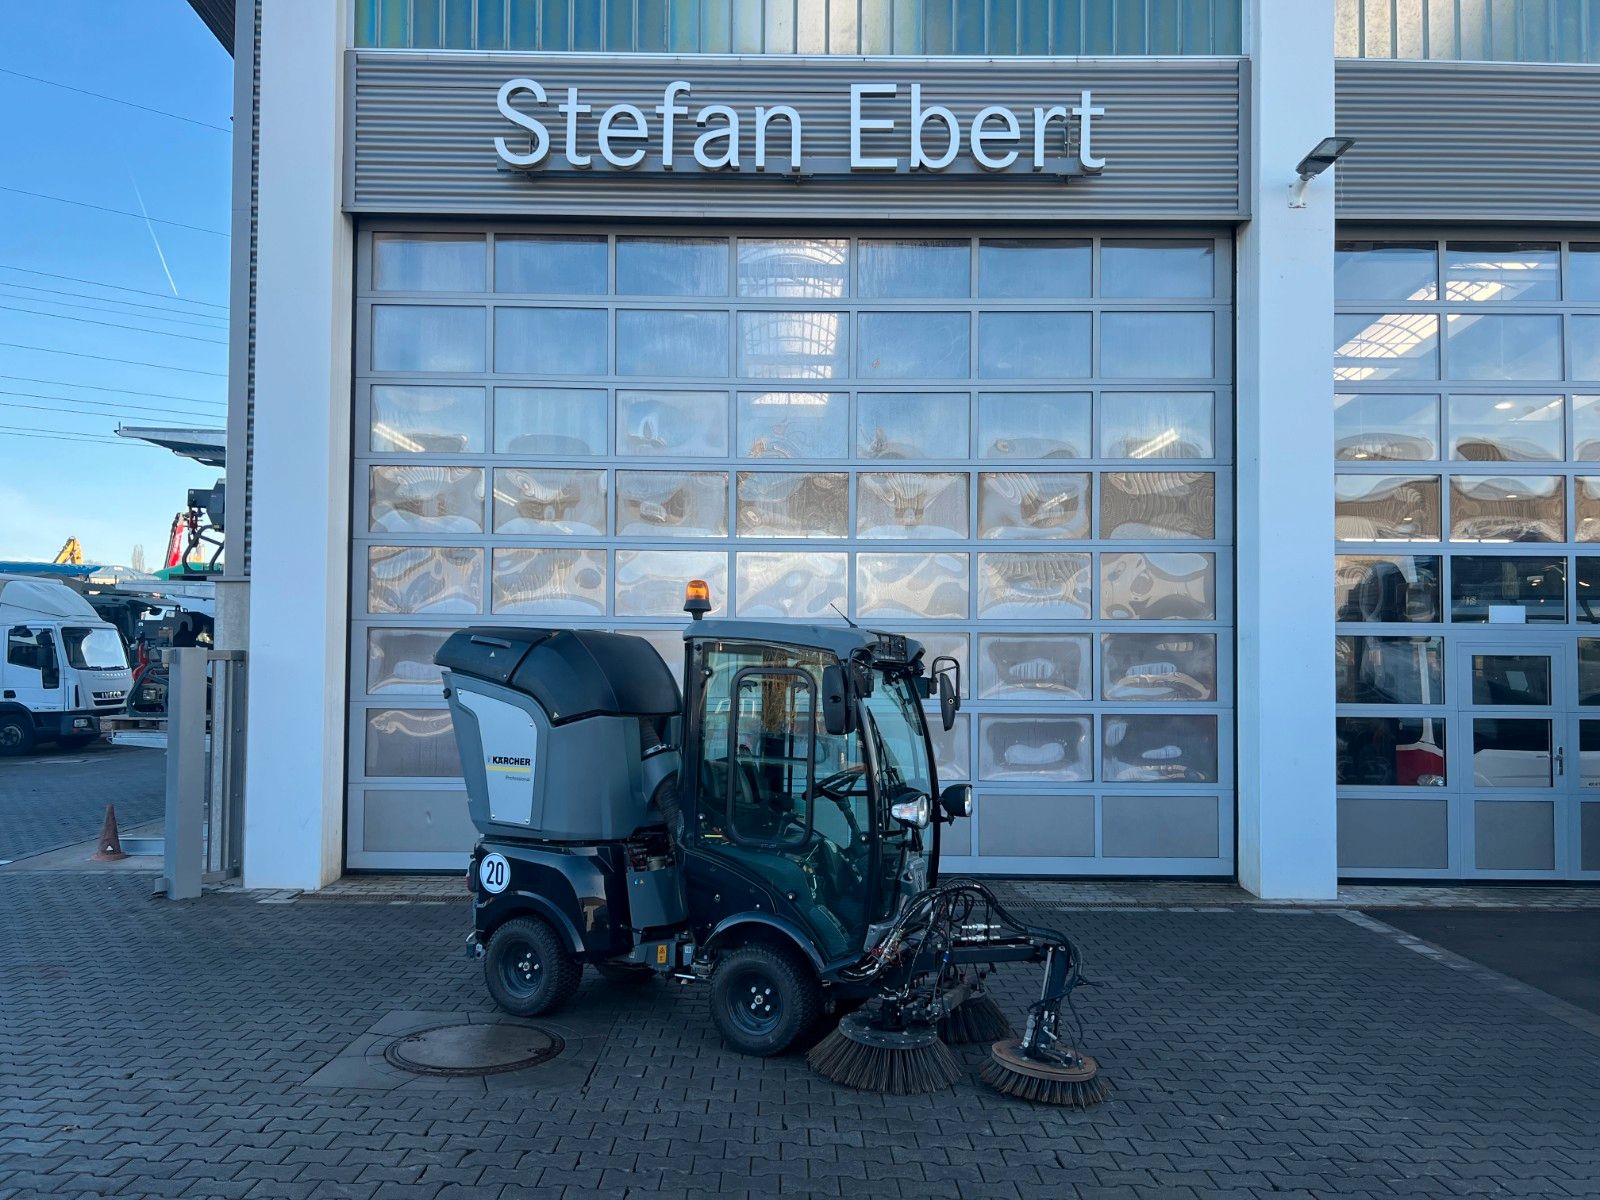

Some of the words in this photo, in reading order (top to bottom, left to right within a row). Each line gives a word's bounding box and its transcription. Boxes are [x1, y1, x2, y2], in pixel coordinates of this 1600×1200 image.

[494, 79, 800, 169] Stefan
[851, 83, 1106, 169] Ebert
[492, 756, 531, 765] KÄRCHER
[486, 860, 504, 886] 20
